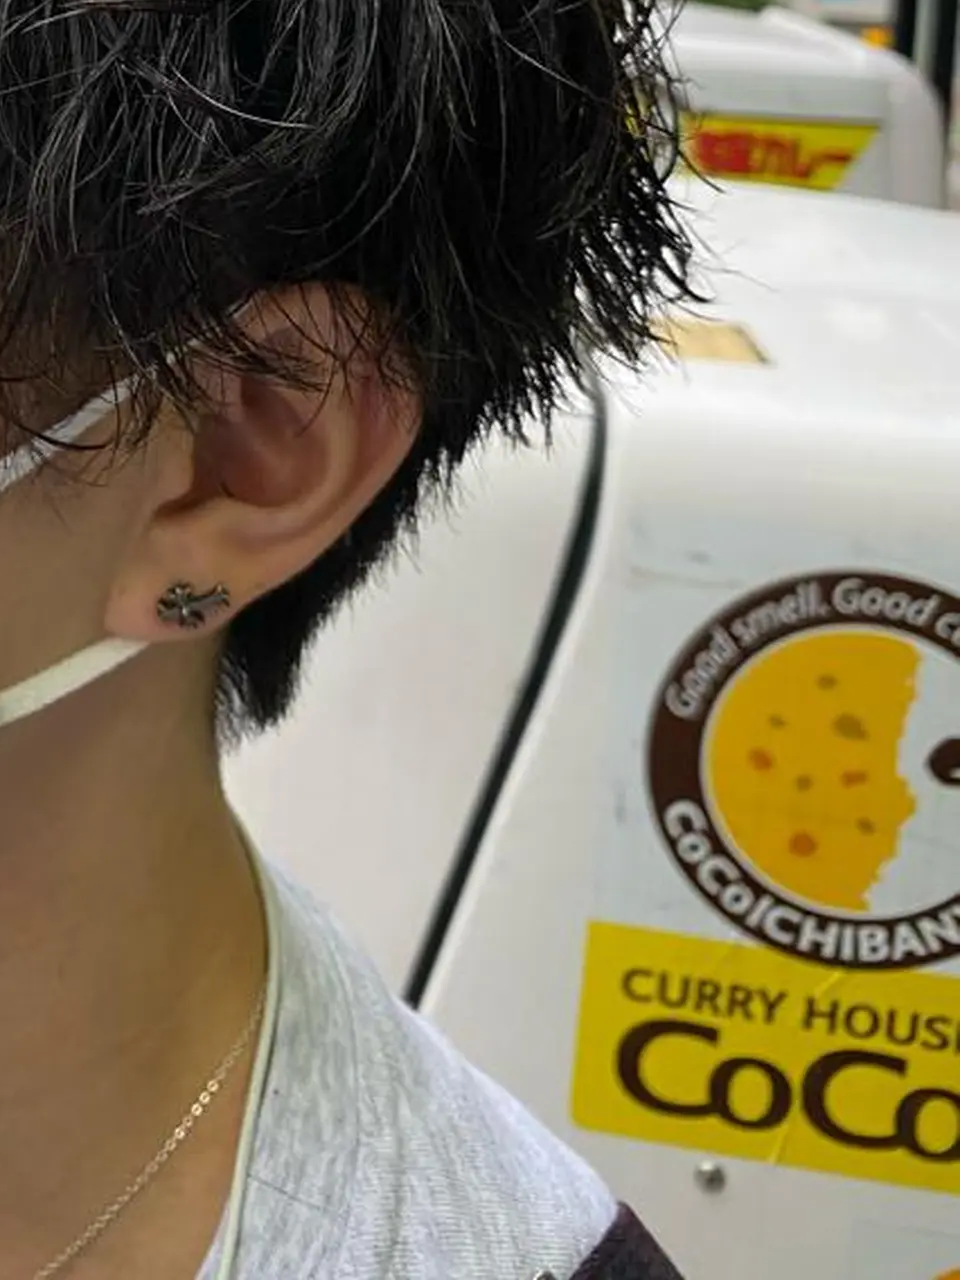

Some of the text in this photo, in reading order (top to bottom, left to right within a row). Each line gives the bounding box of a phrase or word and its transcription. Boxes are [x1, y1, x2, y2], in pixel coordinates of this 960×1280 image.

[665, 621, 740, 718] Good
[832, 577, 939, 626] Good
[664, 799, 960, 962] CoCoICHIBAN
[621, 968, 960, 1056] CURRY HOUS
